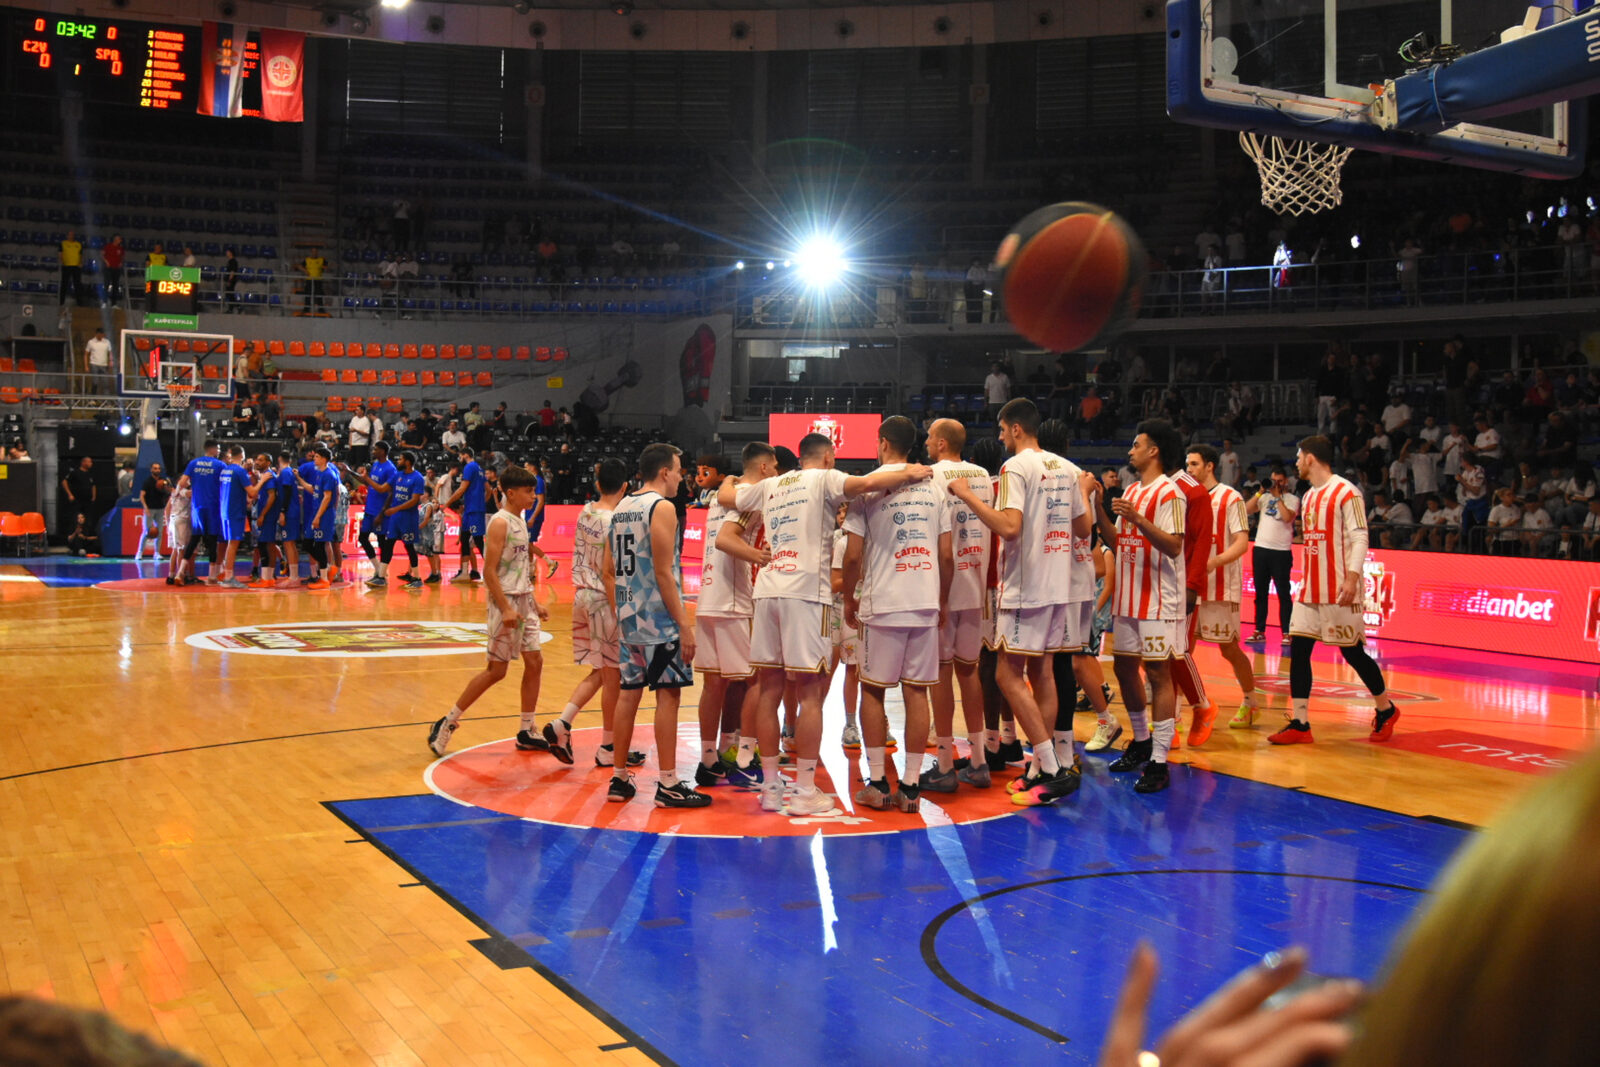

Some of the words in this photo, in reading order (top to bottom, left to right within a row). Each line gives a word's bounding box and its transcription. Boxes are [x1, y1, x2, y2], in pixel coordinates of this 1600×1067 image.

[35, 18, 45, 32] 0
[57, 21, 96, 39] 03:42
[107, 26, 117, 40] 0
[40, 53, 51, 68] 0
[96, 48, 120, 61] SPA
[74, 64, 80, 75] 1
[112, 61, 123, 75] 0
[158, 281, 192, 294] 03:42
[314, 530, 323, 538] 20
[402, 533, 414, 542] 23
[616, 534, 636, 576] 15
[772, 549, 798, 562] arnex
[895, 546, 931, 559] carnex
[957, 546, 983, 558] carn
[957, 562, 982, 571] BY
[1211, 623, 1230, 637] 44
[1336, 624, 1355, 639] 50
[1144, 636, 1165, 652] 33
[1438, 743, 1573, 768] mts
